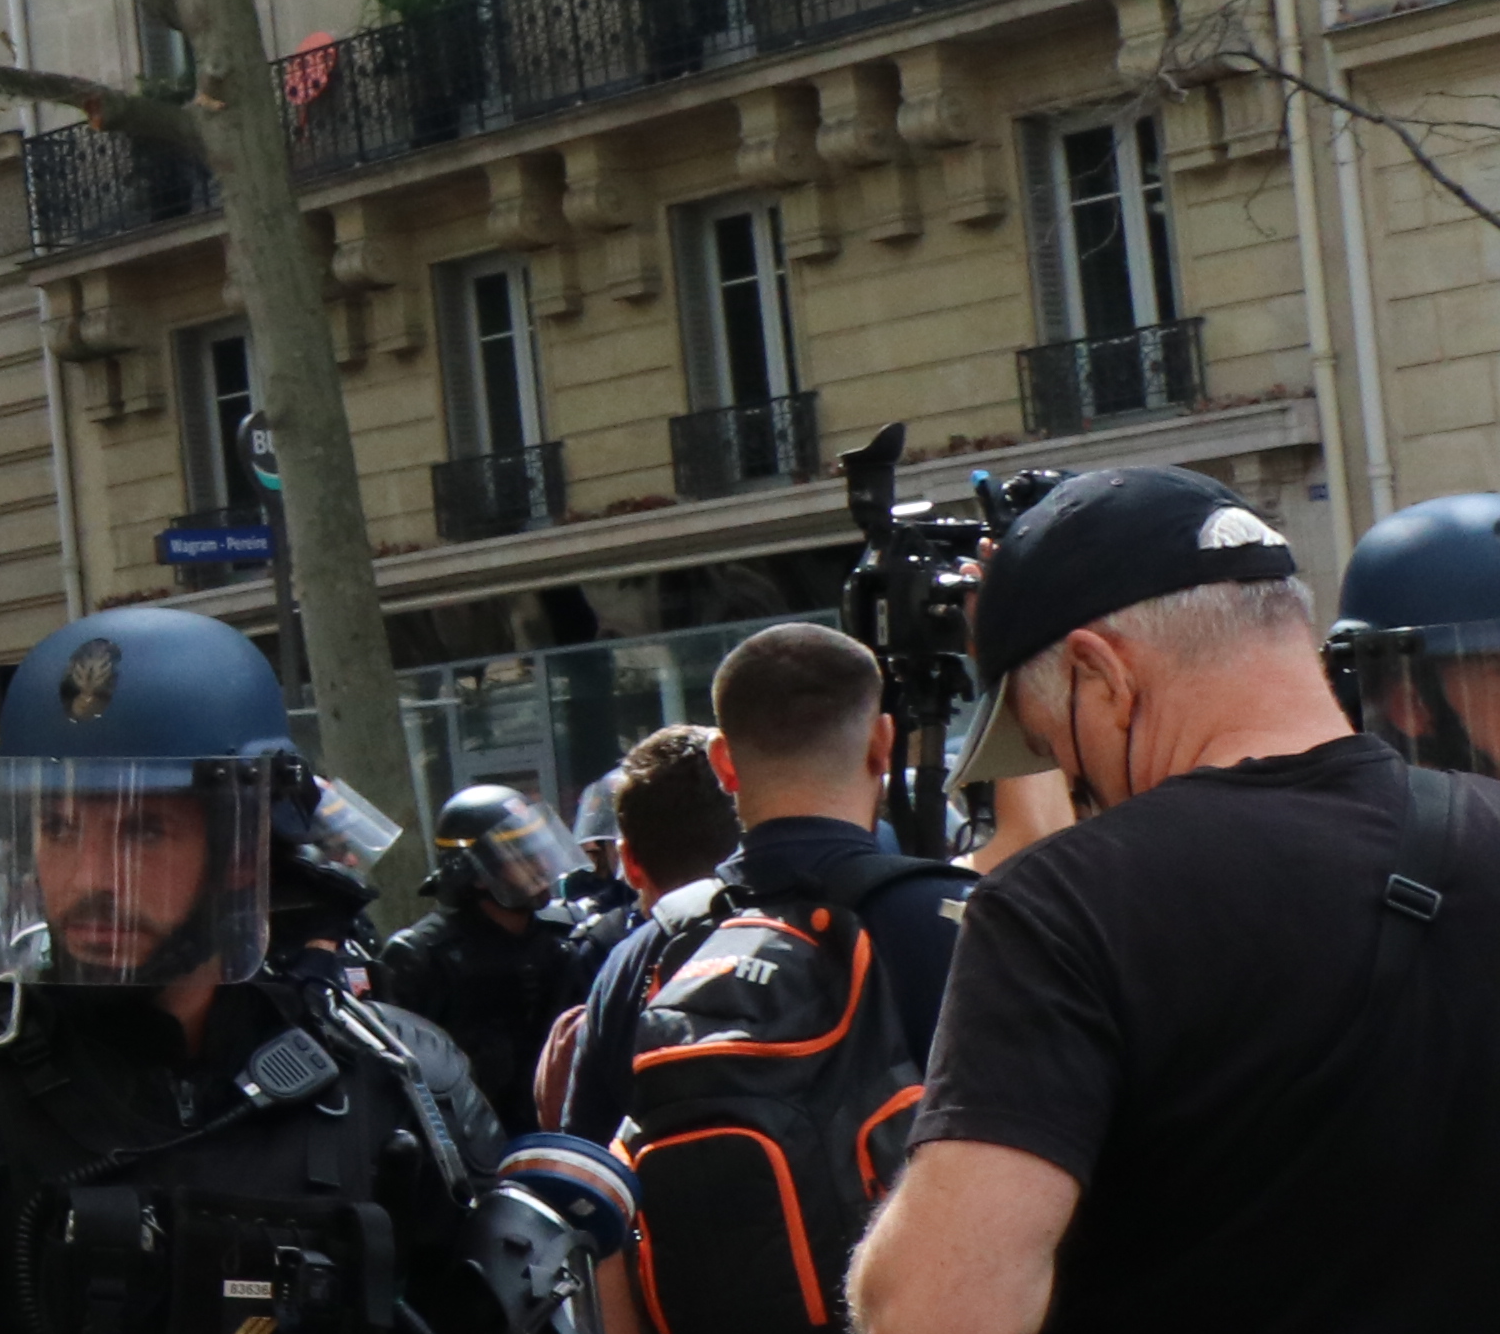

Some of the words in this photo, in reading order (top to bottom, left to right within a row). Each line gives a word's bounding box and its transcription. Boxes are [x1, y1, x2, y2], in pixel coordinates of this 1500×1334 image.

[253, 429, 275, 454] BU
[170, 538, 218, 556] Wagram
[226, 535, 268, 550] Pereire
